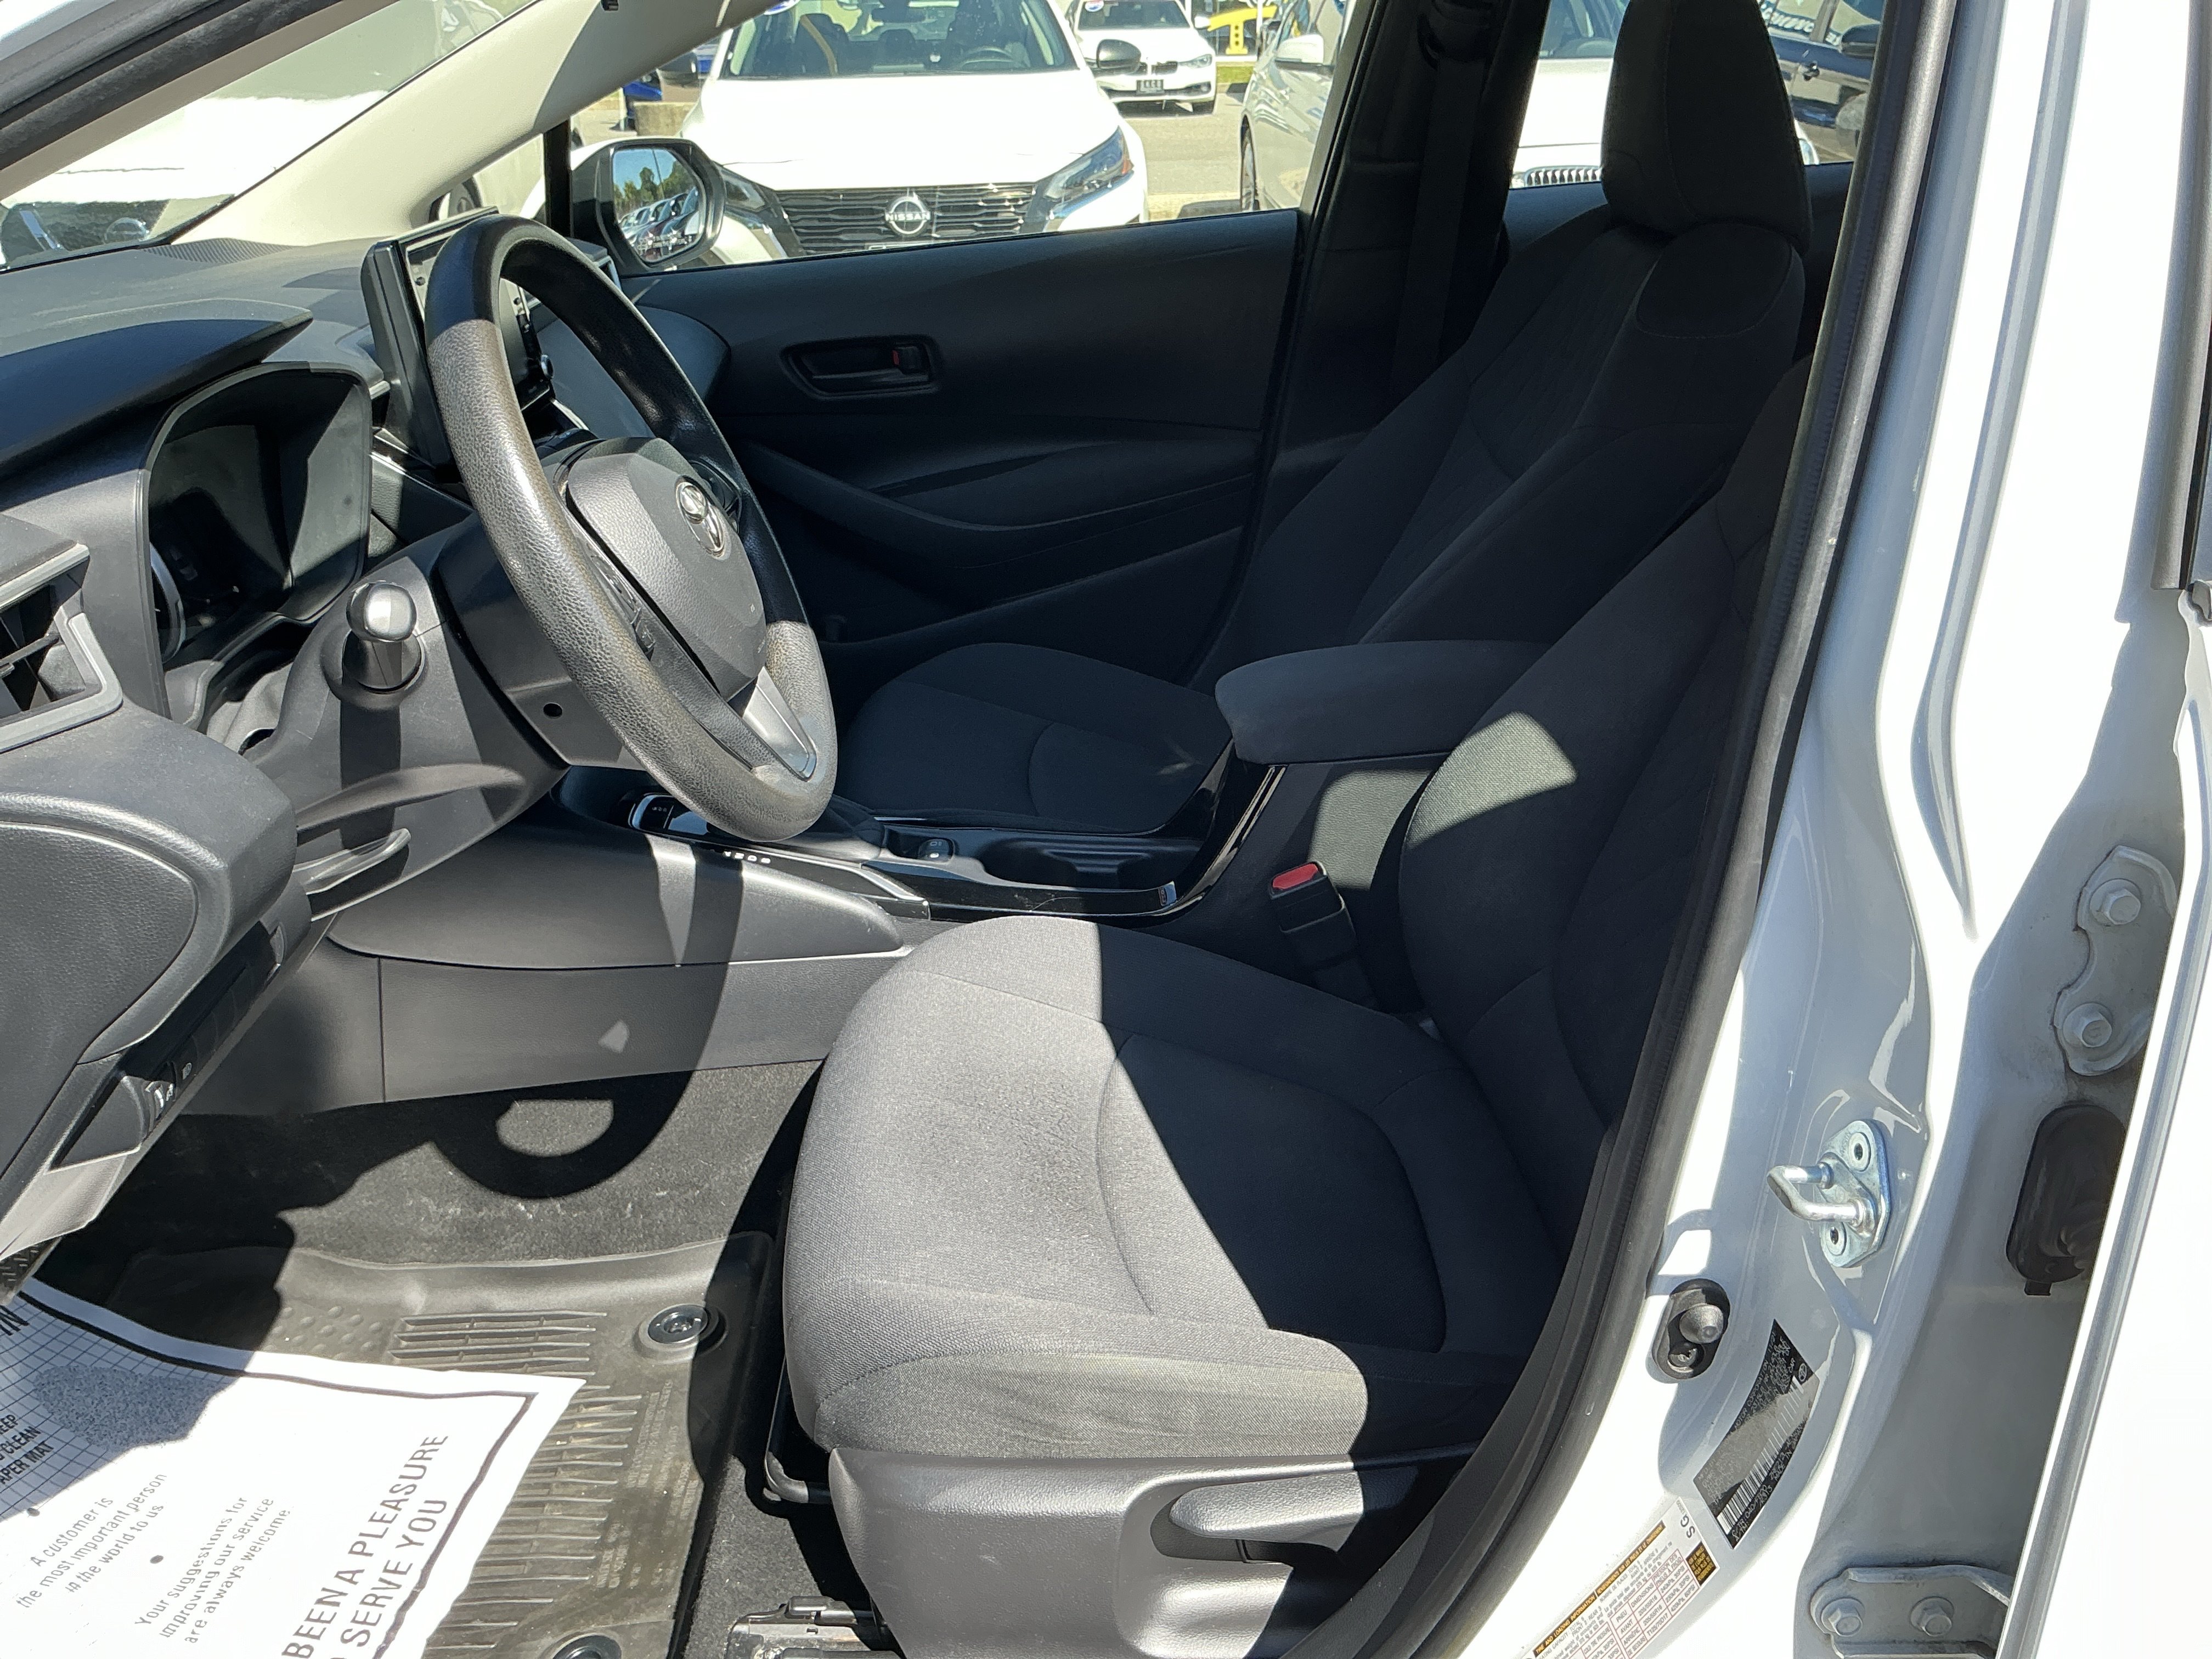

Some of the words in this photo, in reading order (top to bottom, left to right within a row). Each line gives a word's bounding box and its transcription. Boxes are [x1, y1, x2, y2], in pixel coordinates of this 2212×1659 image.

[885, 212, 930, 221] NISSAN
[0, 1414, 18, 1435] EEP
[0, 1426, 41, 1454] CLEAN
[22, 1441, 54, 1463] MAT
[30, 1556, 47, 1567] A
[43, 1508, 99, 1558] customer
[94, 1498, 113, 1509] is
[348, 1436, 449, 1557] PLEASURE
[16, 1590, 42, 1608] the
[40, 1560, 75, 1587] most
[70, 1510, 131, 1560] important
[126, 1474, 167, 1513] person
[76, 1566, 101, 1582] the
[98, 1533, 135, 1564] world
[129, 1521, 149, 1532] to
[145, 1505, 163, 1519] us
[134, 1599, 170, 1624] Your
[167, 1518, 233, 1598] suggestions
[225, 1497, 247, 1513] for
[159, 1571, 220, 1638] improving
[214, 1544, 235, 1566] our
[232, 1499, 274, 1541] service
[184, 1620, 207, 1644] are
[204, 1565, 245, 1613] always
[240, 1510, 290, 1561] welcome
[334, 1568, 365, 1585] A
[340, 1559, 414, 1648] SERVE
[394, 1499, 448, 1549] YOU
[281, 1587, 349, 1659] BEEN
